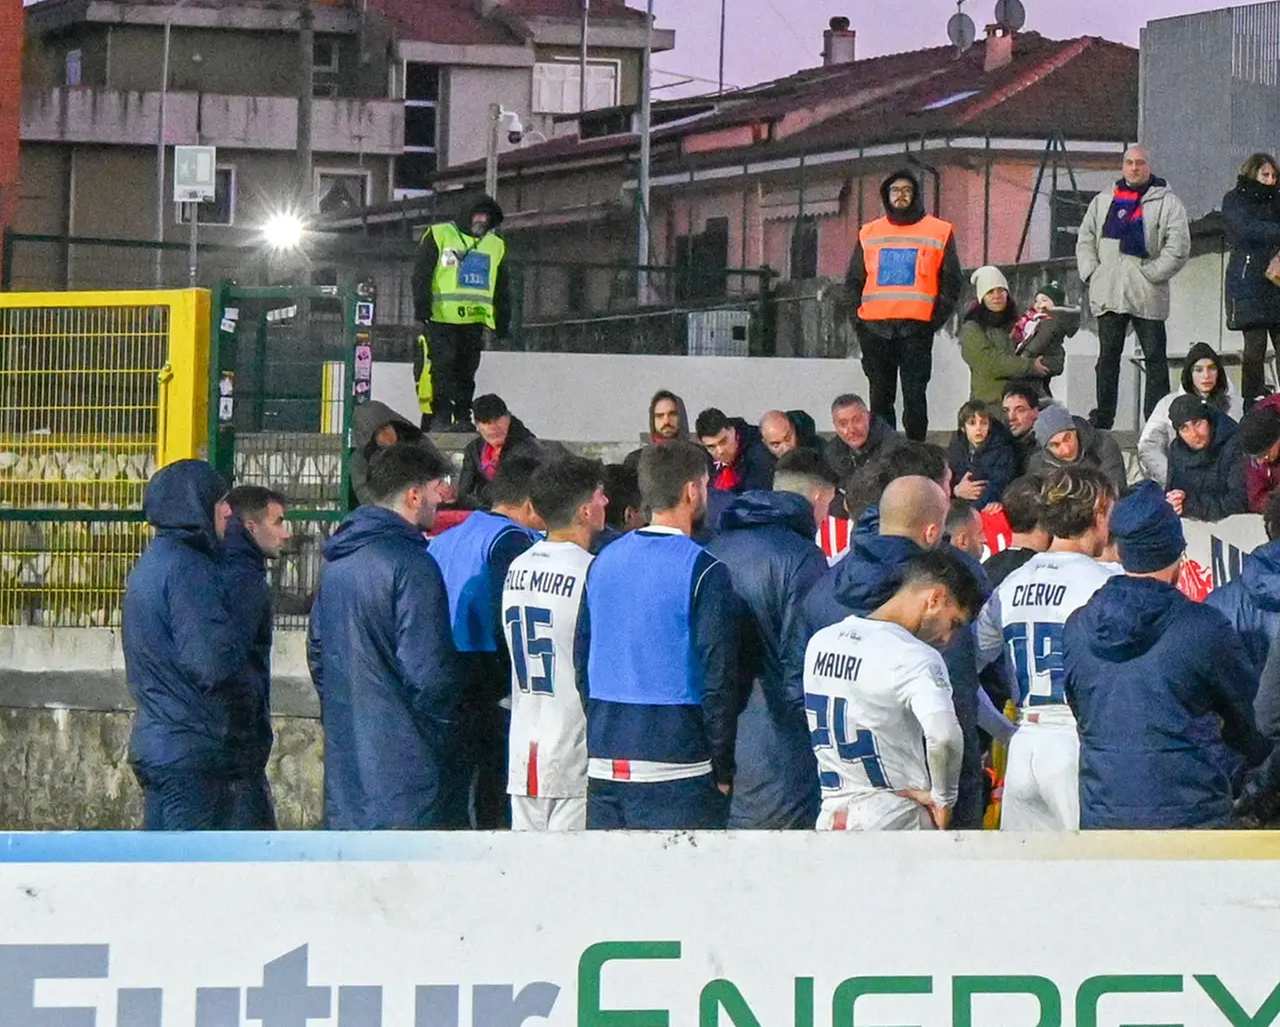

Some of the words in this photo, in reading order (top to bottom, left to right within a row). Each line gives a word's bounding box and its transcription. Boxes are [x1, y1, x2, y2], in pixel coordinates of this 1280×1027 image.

[530, 570, 576, 598] MURA
[1012, 583, 1068, 607] CIERVO
[505, 605, 556, 697] 15
[812, 651, 863, 682] MAURI
[805, 692, 893, 791] 24
